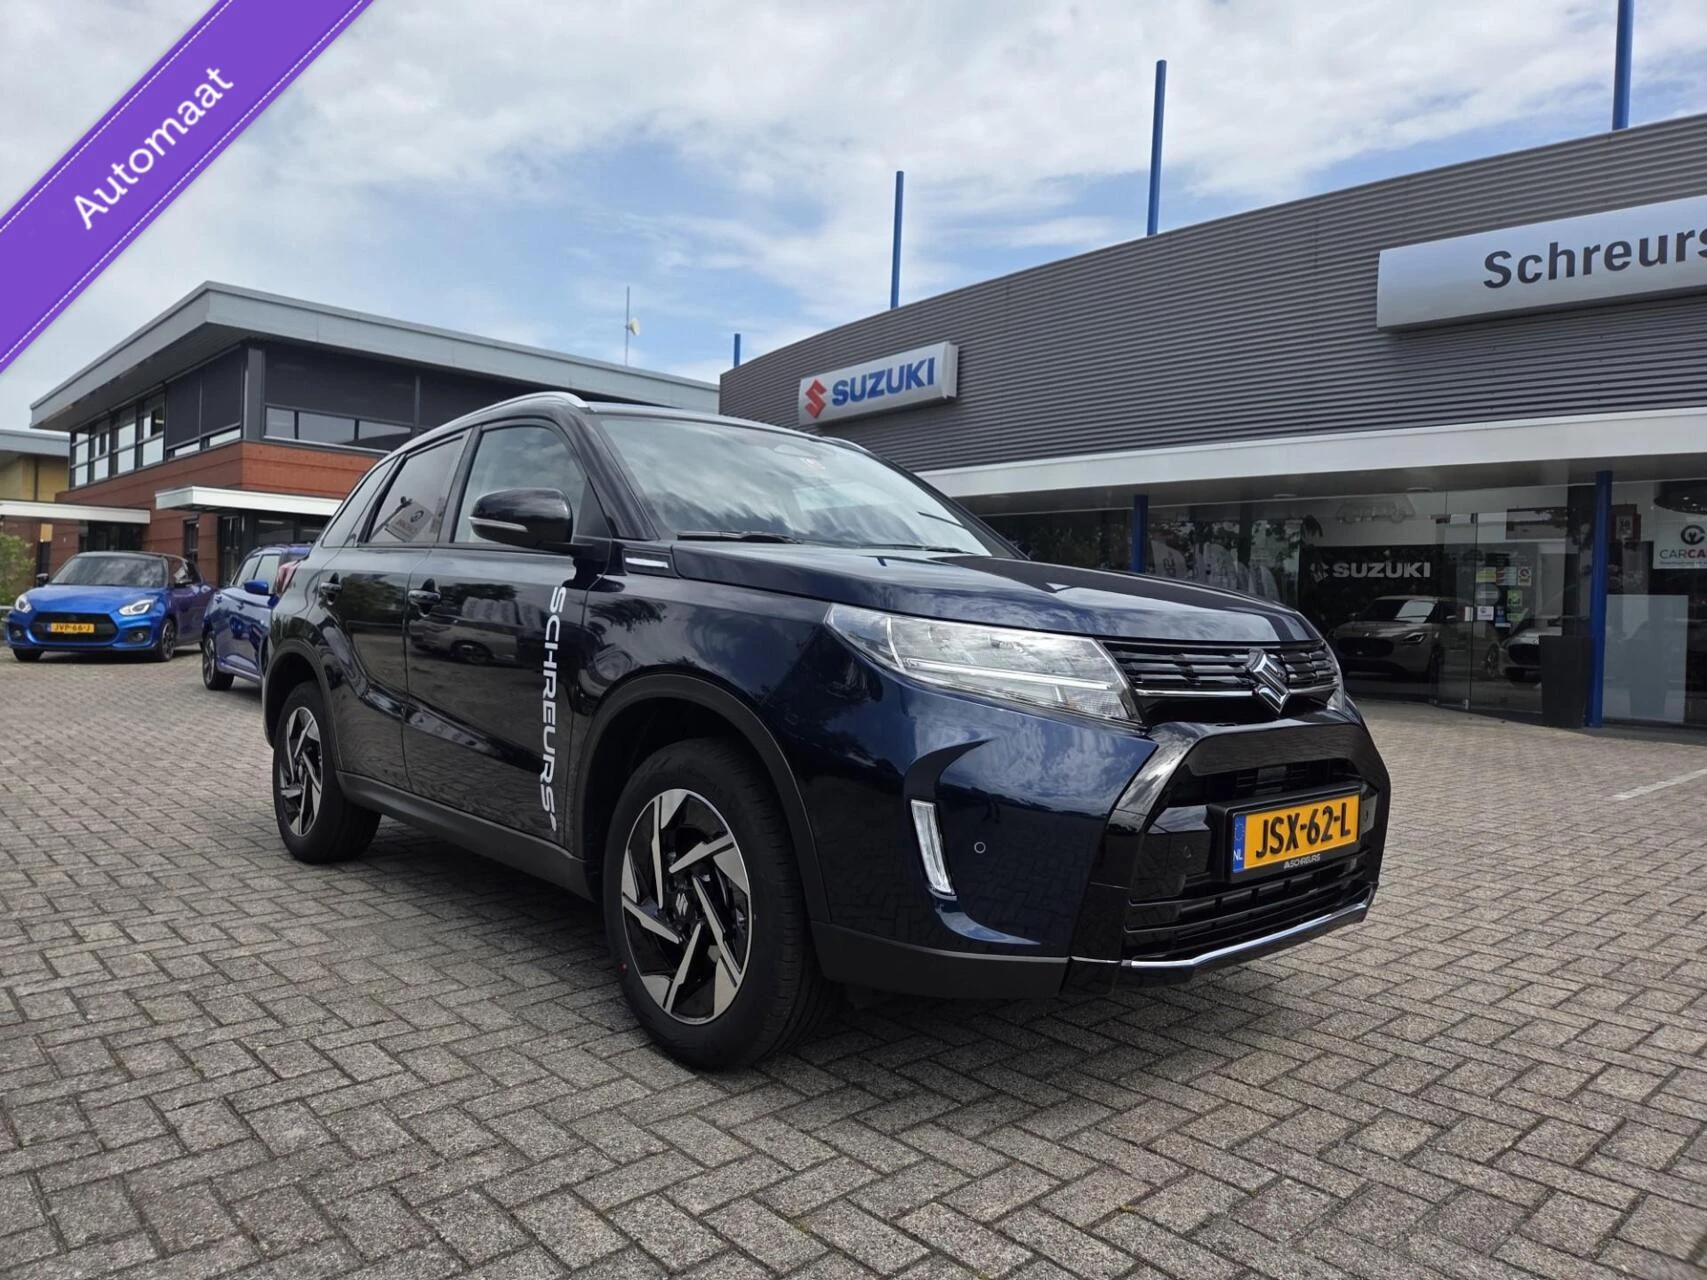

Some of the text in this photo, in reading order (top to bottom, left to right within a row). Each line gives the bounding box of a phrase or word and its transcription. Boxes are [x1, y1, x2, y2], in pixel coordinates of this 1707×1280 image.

[831, 357, 936, 407] SUZUKI
[1332, 561, 1431, 578] SUZUKI
[540, 586, 567, 813] SCHREURS
[1233, 848, 1243, 861] NL
[1256, 802, 1351, 859] JSX-62-L
